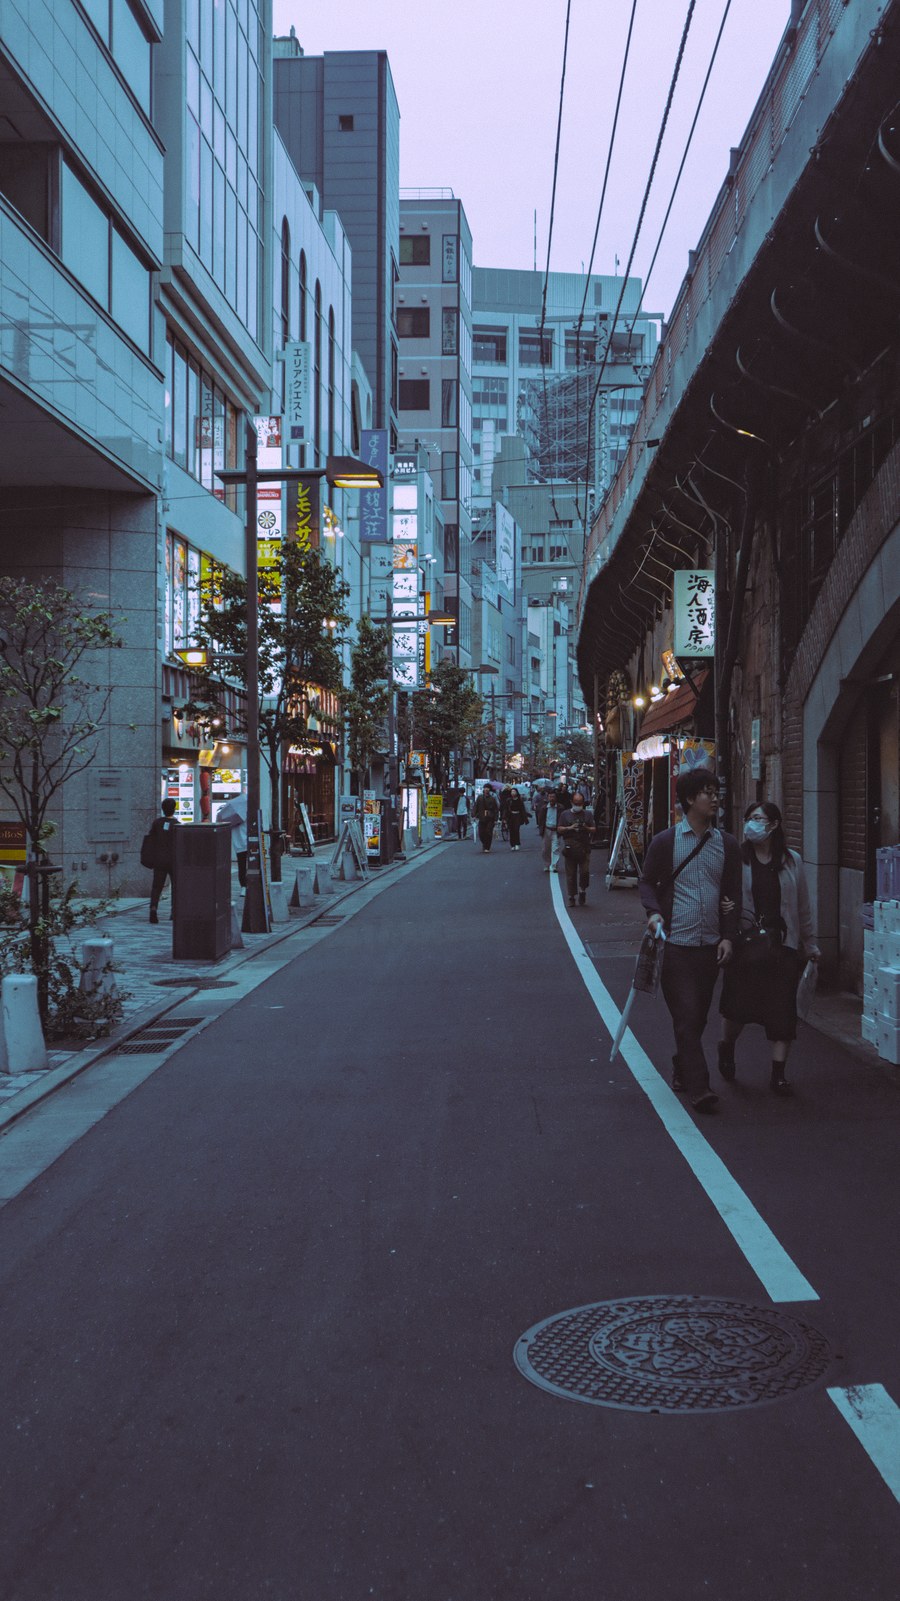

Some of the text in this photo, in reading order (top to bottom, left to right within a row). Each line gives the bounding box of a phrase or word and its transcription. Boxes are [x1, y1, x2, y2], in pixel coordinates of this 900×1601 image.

[293, 348, 302, 421] エリアクエスト
[686, 574, 712, 645] 海人酒房
